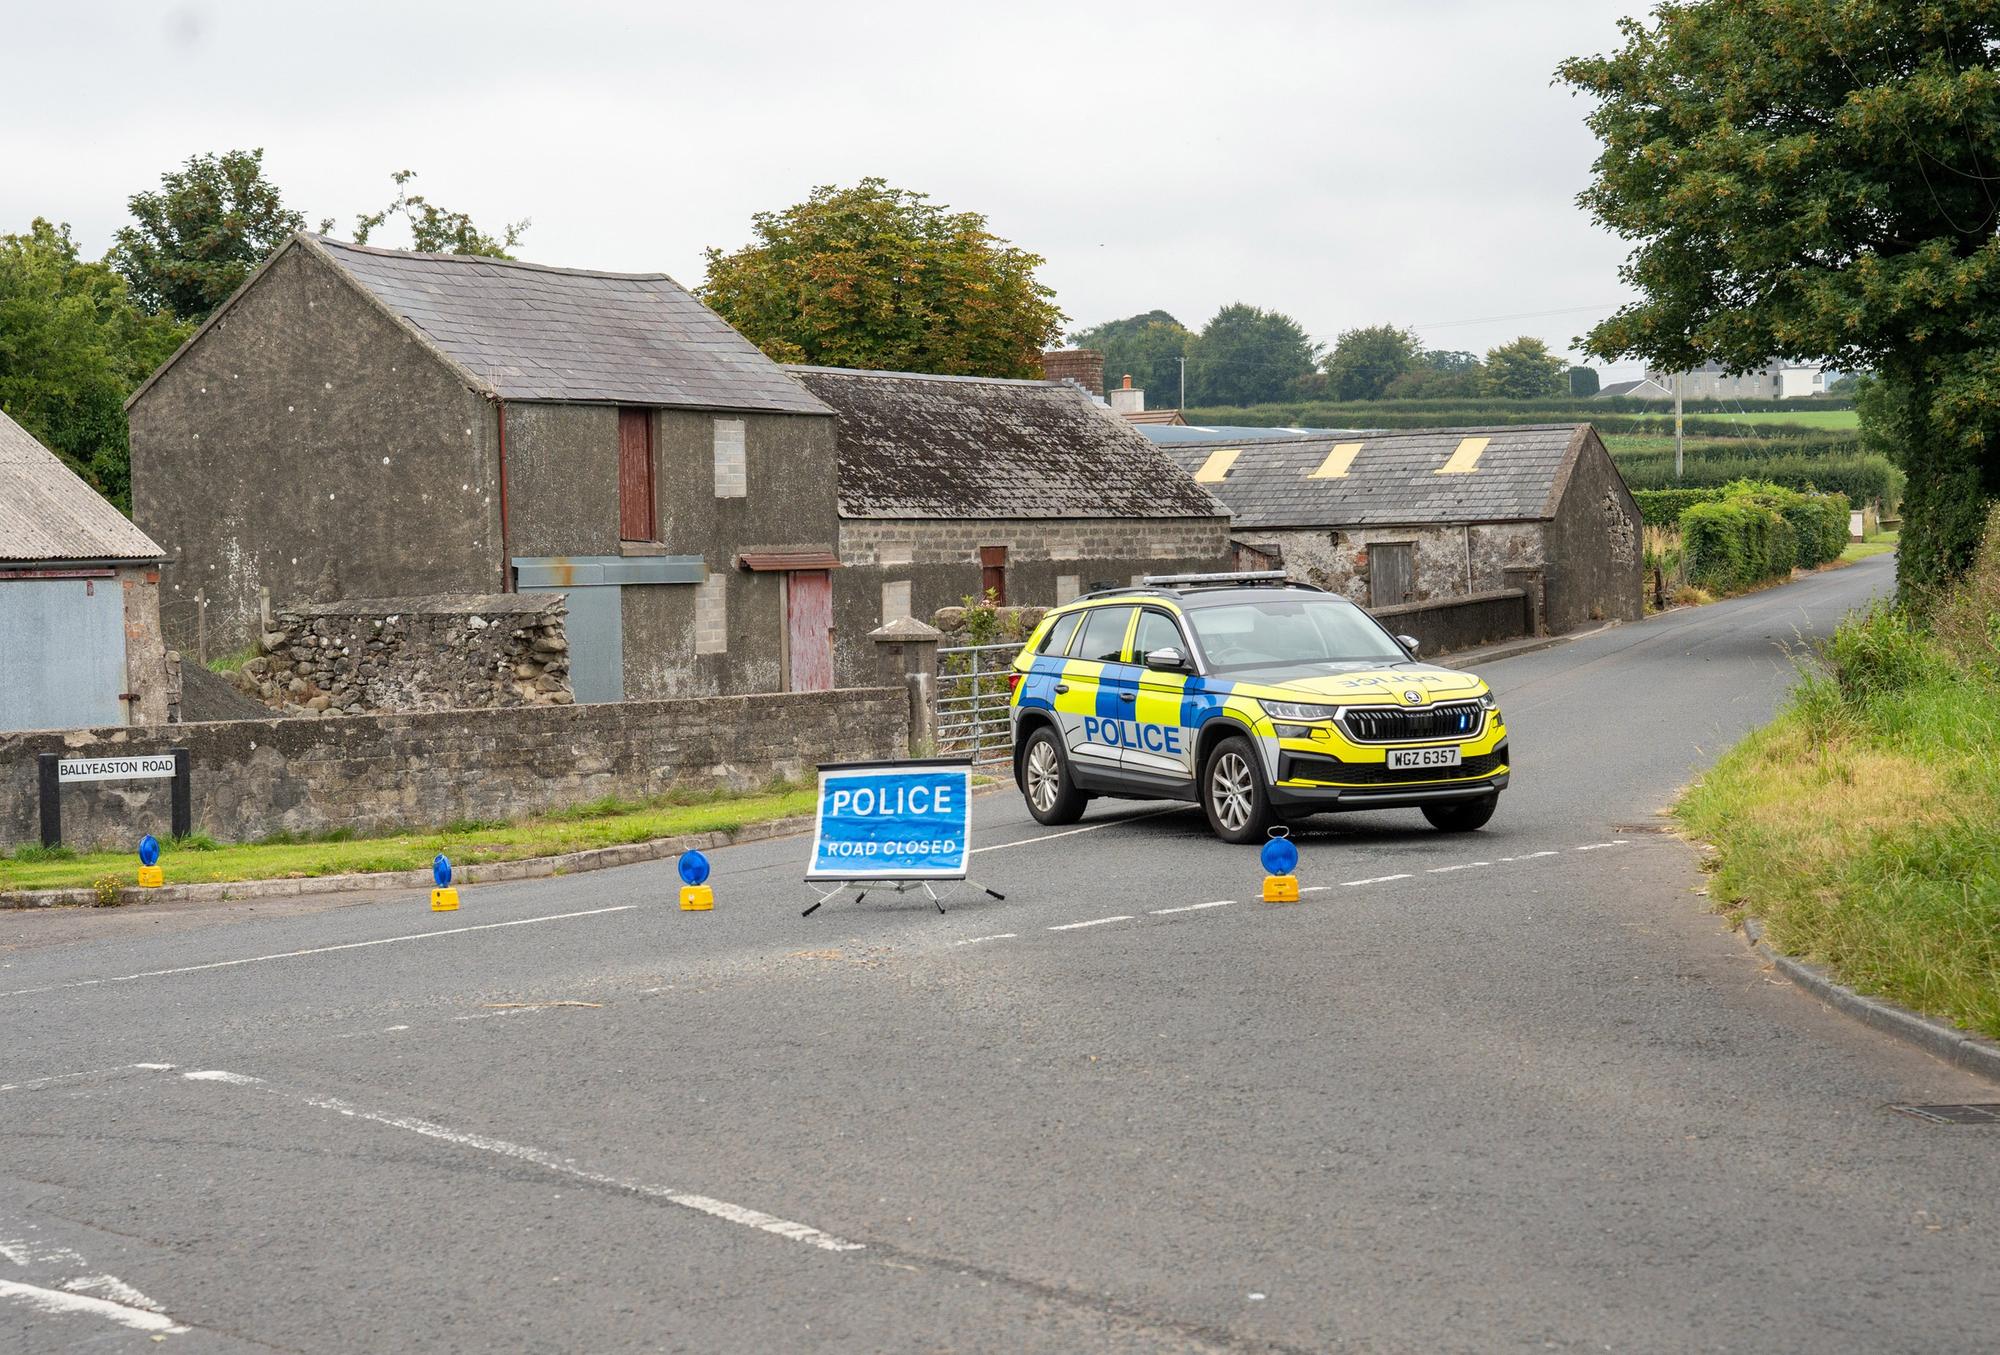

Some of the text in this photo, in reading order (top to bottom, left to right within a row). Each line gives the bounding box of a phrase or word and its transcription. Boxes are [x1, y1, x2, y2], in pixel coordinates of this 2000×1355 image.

[1084, 716, 1182, 754] POLICE
[60, 760, 173, 775] BALLYEASTON ROAD
[1395, 750, 1456, 767] WGZ 6357
[832, 785, 952, 817] POLICE
[827, 839, 956, 857] ROAD CLOSED
